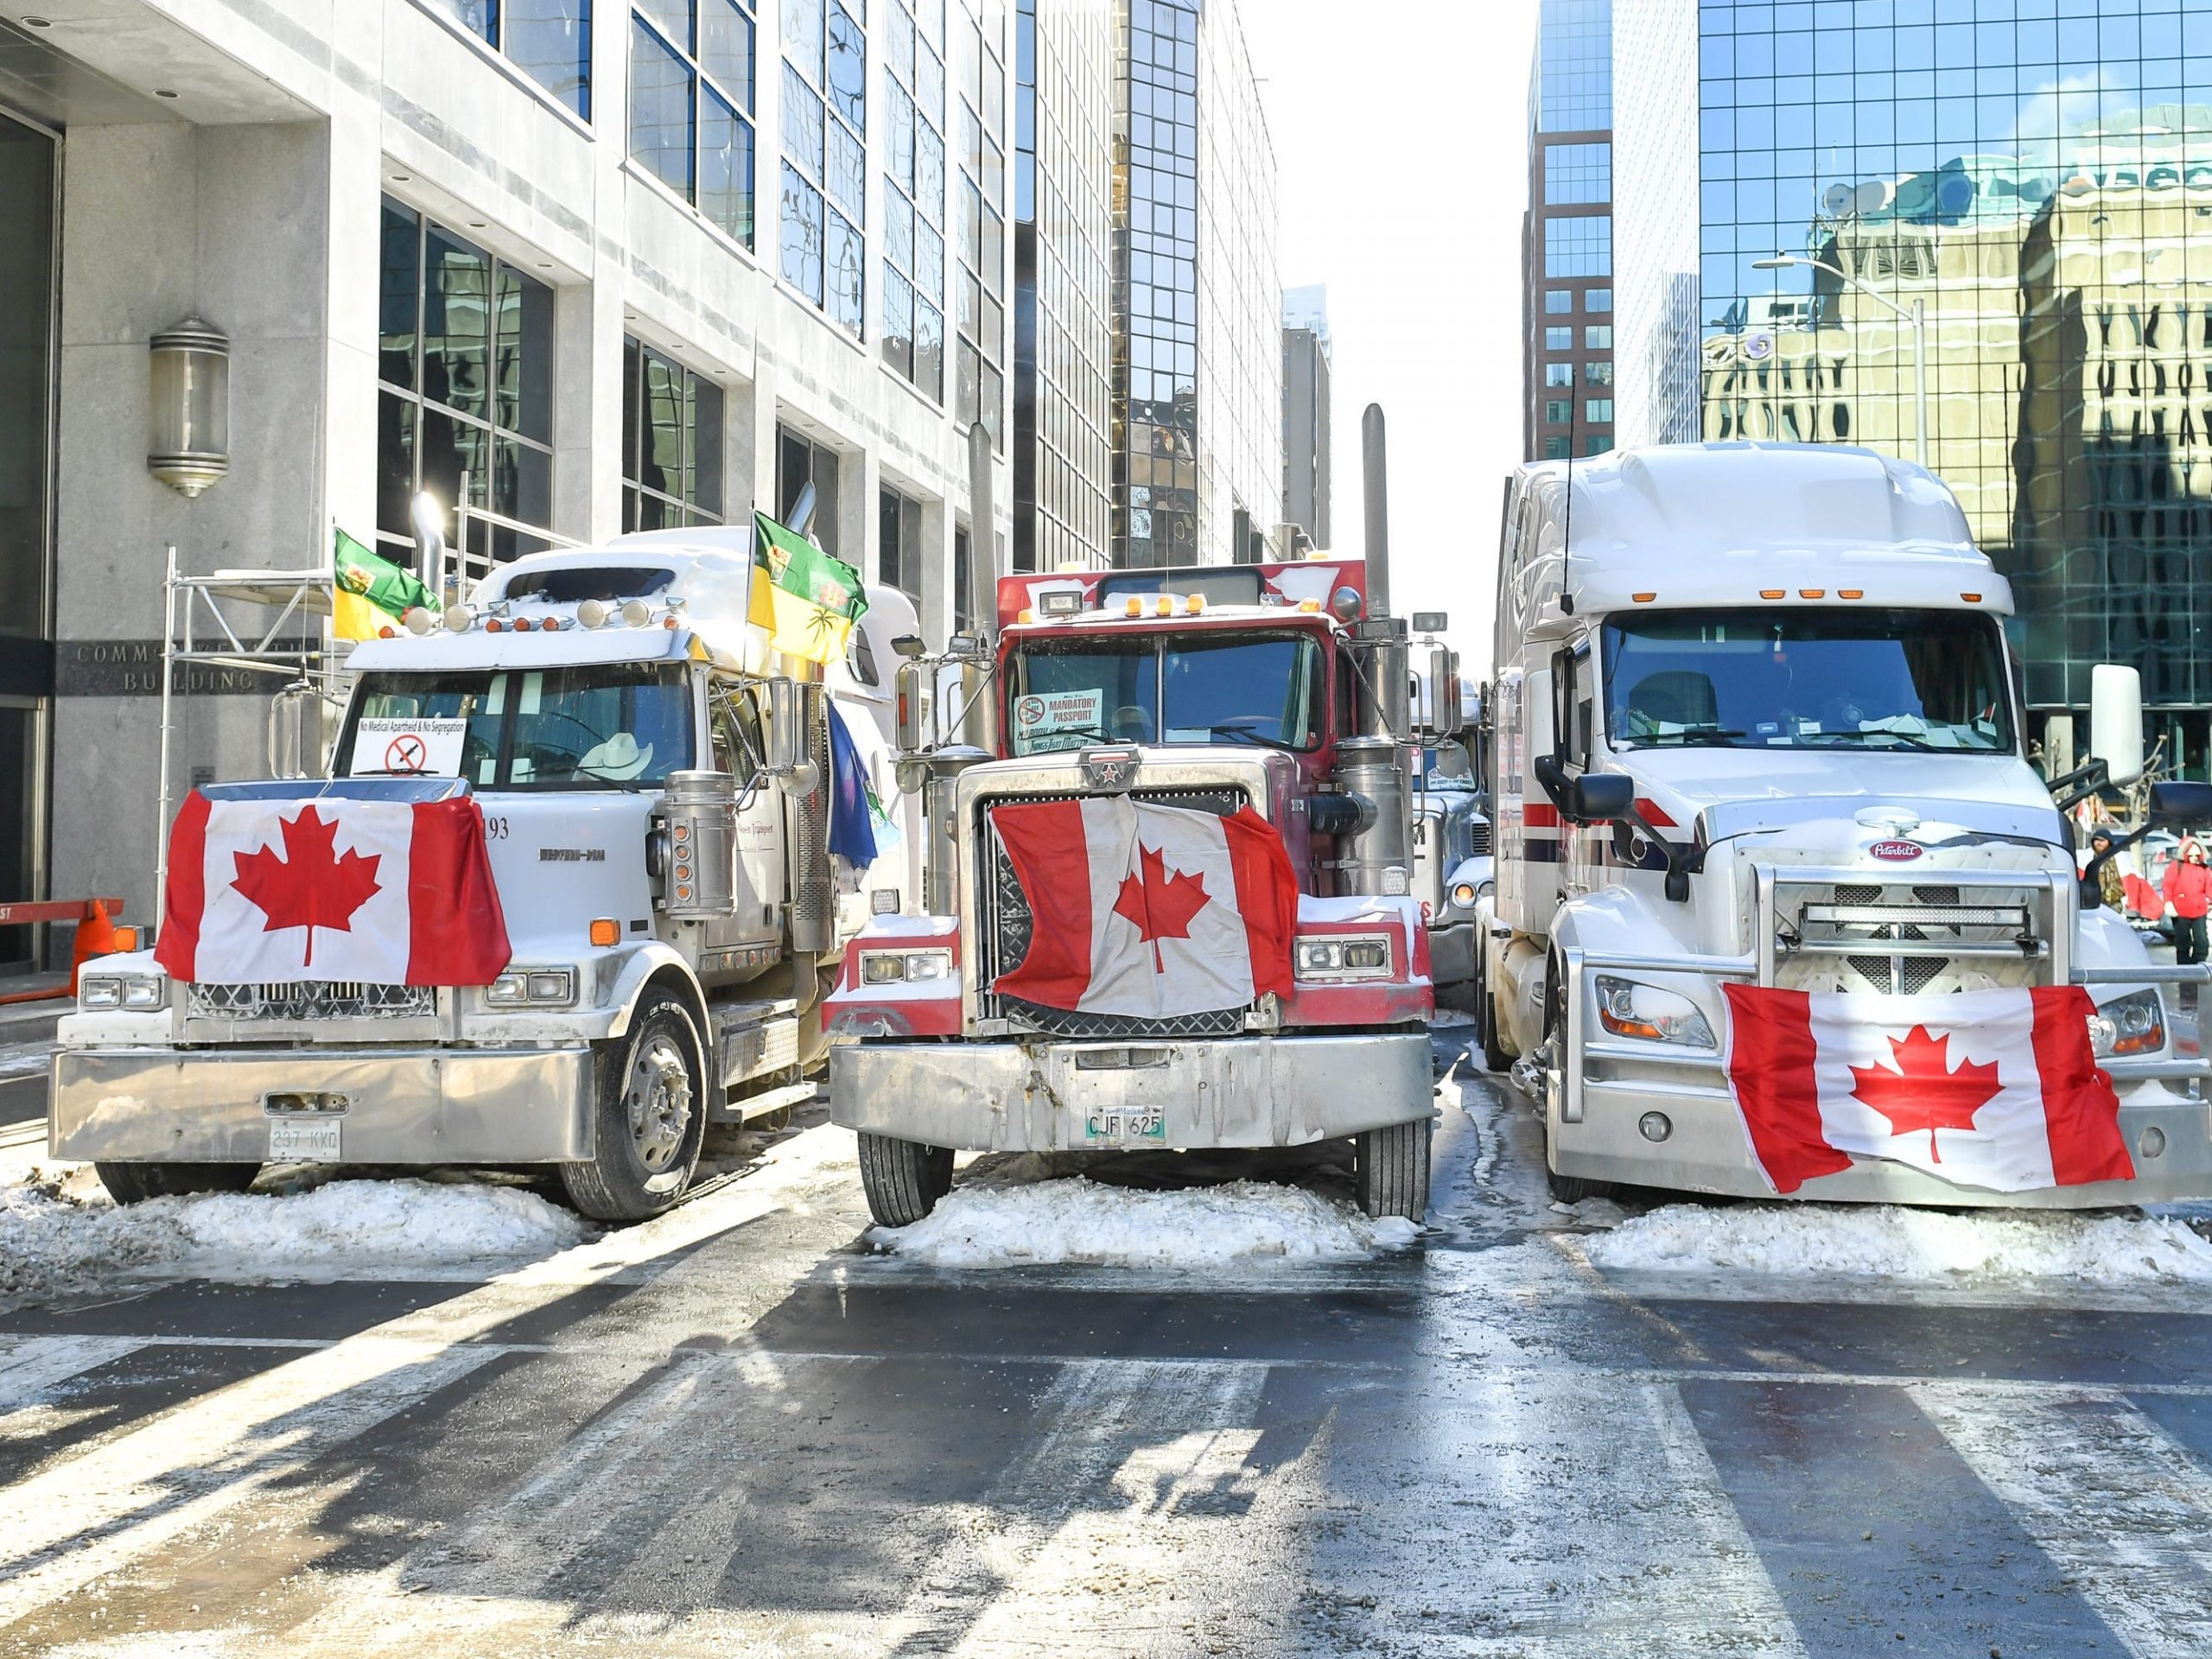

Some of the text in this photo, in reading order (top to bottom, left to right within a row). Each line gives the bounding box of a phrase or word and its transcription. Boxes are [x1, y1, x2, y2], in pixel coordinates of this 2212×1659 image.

[124, 672, 253, 690] BULDING
[1049, 697, 1096, 711] MANDATORY
[1053, 709, 1093, 722] PASSPORT
[359, 721, 367, 732] No
[368, 721, 389, 732] Medical
[390, 721, 417, 734] Apartheid
[423, 721, 431, 732] No
[431, 721, 464, 735] Segregation
[1874, 843, 1917, 856] Peterbilt
[1090, 1116, 1160, 1135] CJF 625
[272, 1130, 300, 1147] 237
